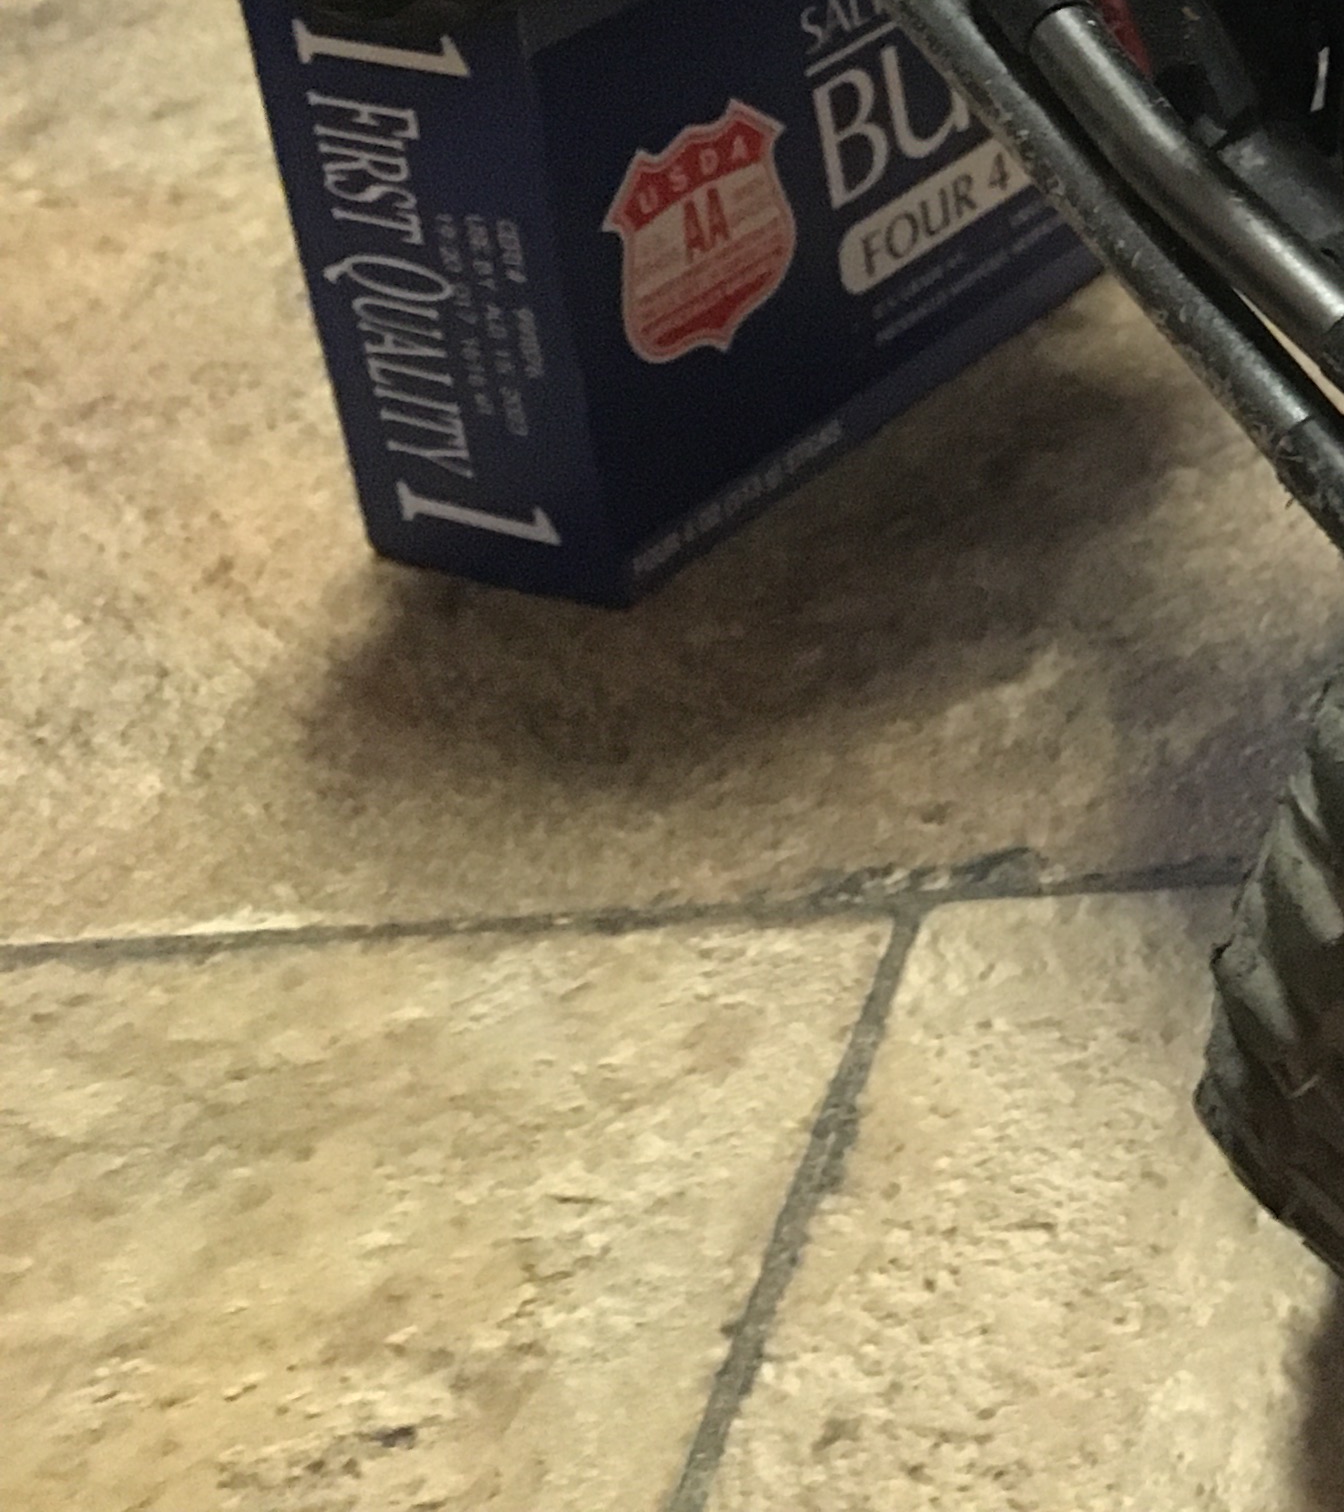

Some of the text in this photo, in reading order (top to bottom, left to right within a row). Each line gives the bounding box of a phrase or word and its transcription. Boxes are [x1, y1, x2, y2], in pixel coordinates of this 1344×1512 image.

[306, 89, 425, 245] FIRST
[859, 172, 979, 278] FOUR
[322, 253, 475, 480] QUALITY
[395, 480, 562, 547] 1
